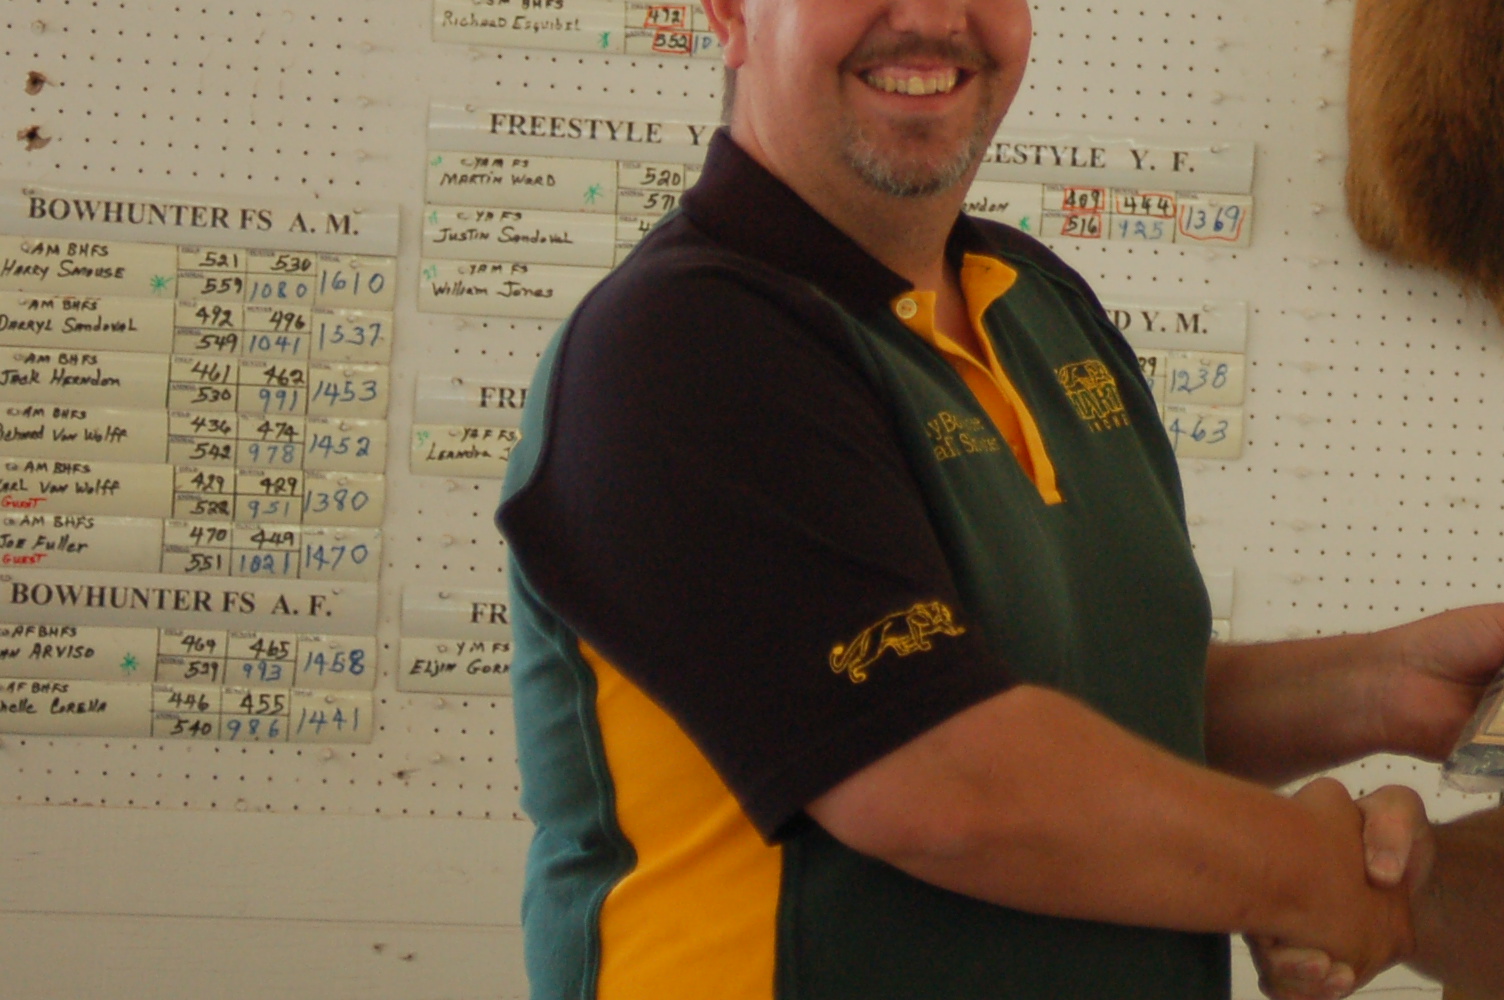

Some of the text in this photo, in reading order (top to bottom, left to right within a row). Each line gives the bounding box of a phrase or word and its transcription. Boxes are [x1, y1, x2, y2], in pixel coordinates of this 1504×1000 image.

[489, 112, 662, 144] FREESTYLE
[1172, 151, 1195, 173] F.
[640, 167, 681, 187] 520
[28, 196, 360, 236] BOWHUNTER FS A. M.
[1185, 205, 1240, 233] 1369
[199, 251, 239, 269] 521
[270, 254, 312, 272] 530
[201, 276, 242, 294] 559
[251, 281, 307, 301] 1080
[319, 269, 385, 296] 1610
[195, 305, 234, 327] 492
[270, 310, 306, 331] 496
[1176, 311, 1208, 335] M.
[195, 333, 239, 354] 549
[249, 334, 301, 355] 1041
[319, 322, 382, 350] 1537
[191, 361, 231, 384] 461
[263, 365, 305, 386] 462
[1170, 363, 1228, 395] 1238
[191, 386, 232, 404] 530
[259, 388, 299, 413] 991
[311, 379, 378, 406] 1453
[249, 443, 295, 465] 978
[308, 433, 371, 459] 1452
[248, 500, 290, 519] 951
[302, 489, 369, 514] 1380
[189, 526, 227, 546] 470
[250, 530, 294, 549] 449
[185, 552, 222, 574] 551
[305, 544, 368, 571] 1470
[10, 581, 333, 617] BOWHUNTER FS A. F.
[239, 693, 285, 716] 455
[169, 718, 213, 736] 540
[296, 706, 359, 735] 1441
